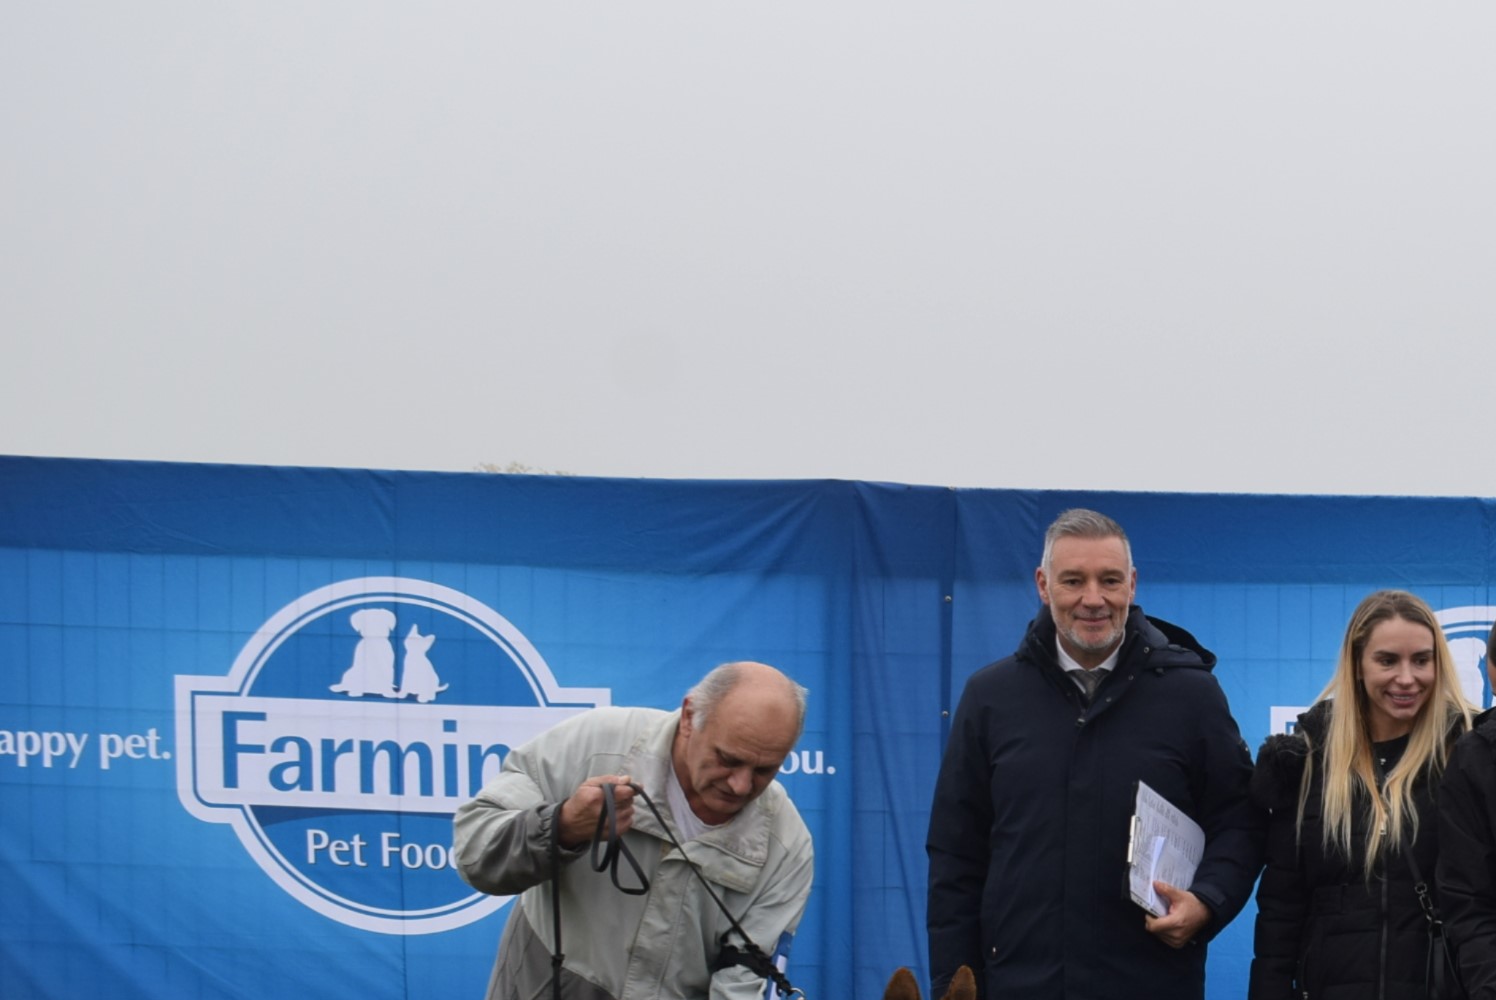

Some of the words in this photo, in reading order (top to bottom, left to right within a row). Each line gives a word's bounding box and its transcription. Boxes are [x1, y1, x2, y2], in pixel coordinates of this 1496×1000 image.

[0, 730, 89, 769] appy
[99, 728, 171, 770] pet.
[221, 710, 513, 800] Farmin
[778, 750, 837, 775] ou.
[305, 828, 368, 868] Pet
